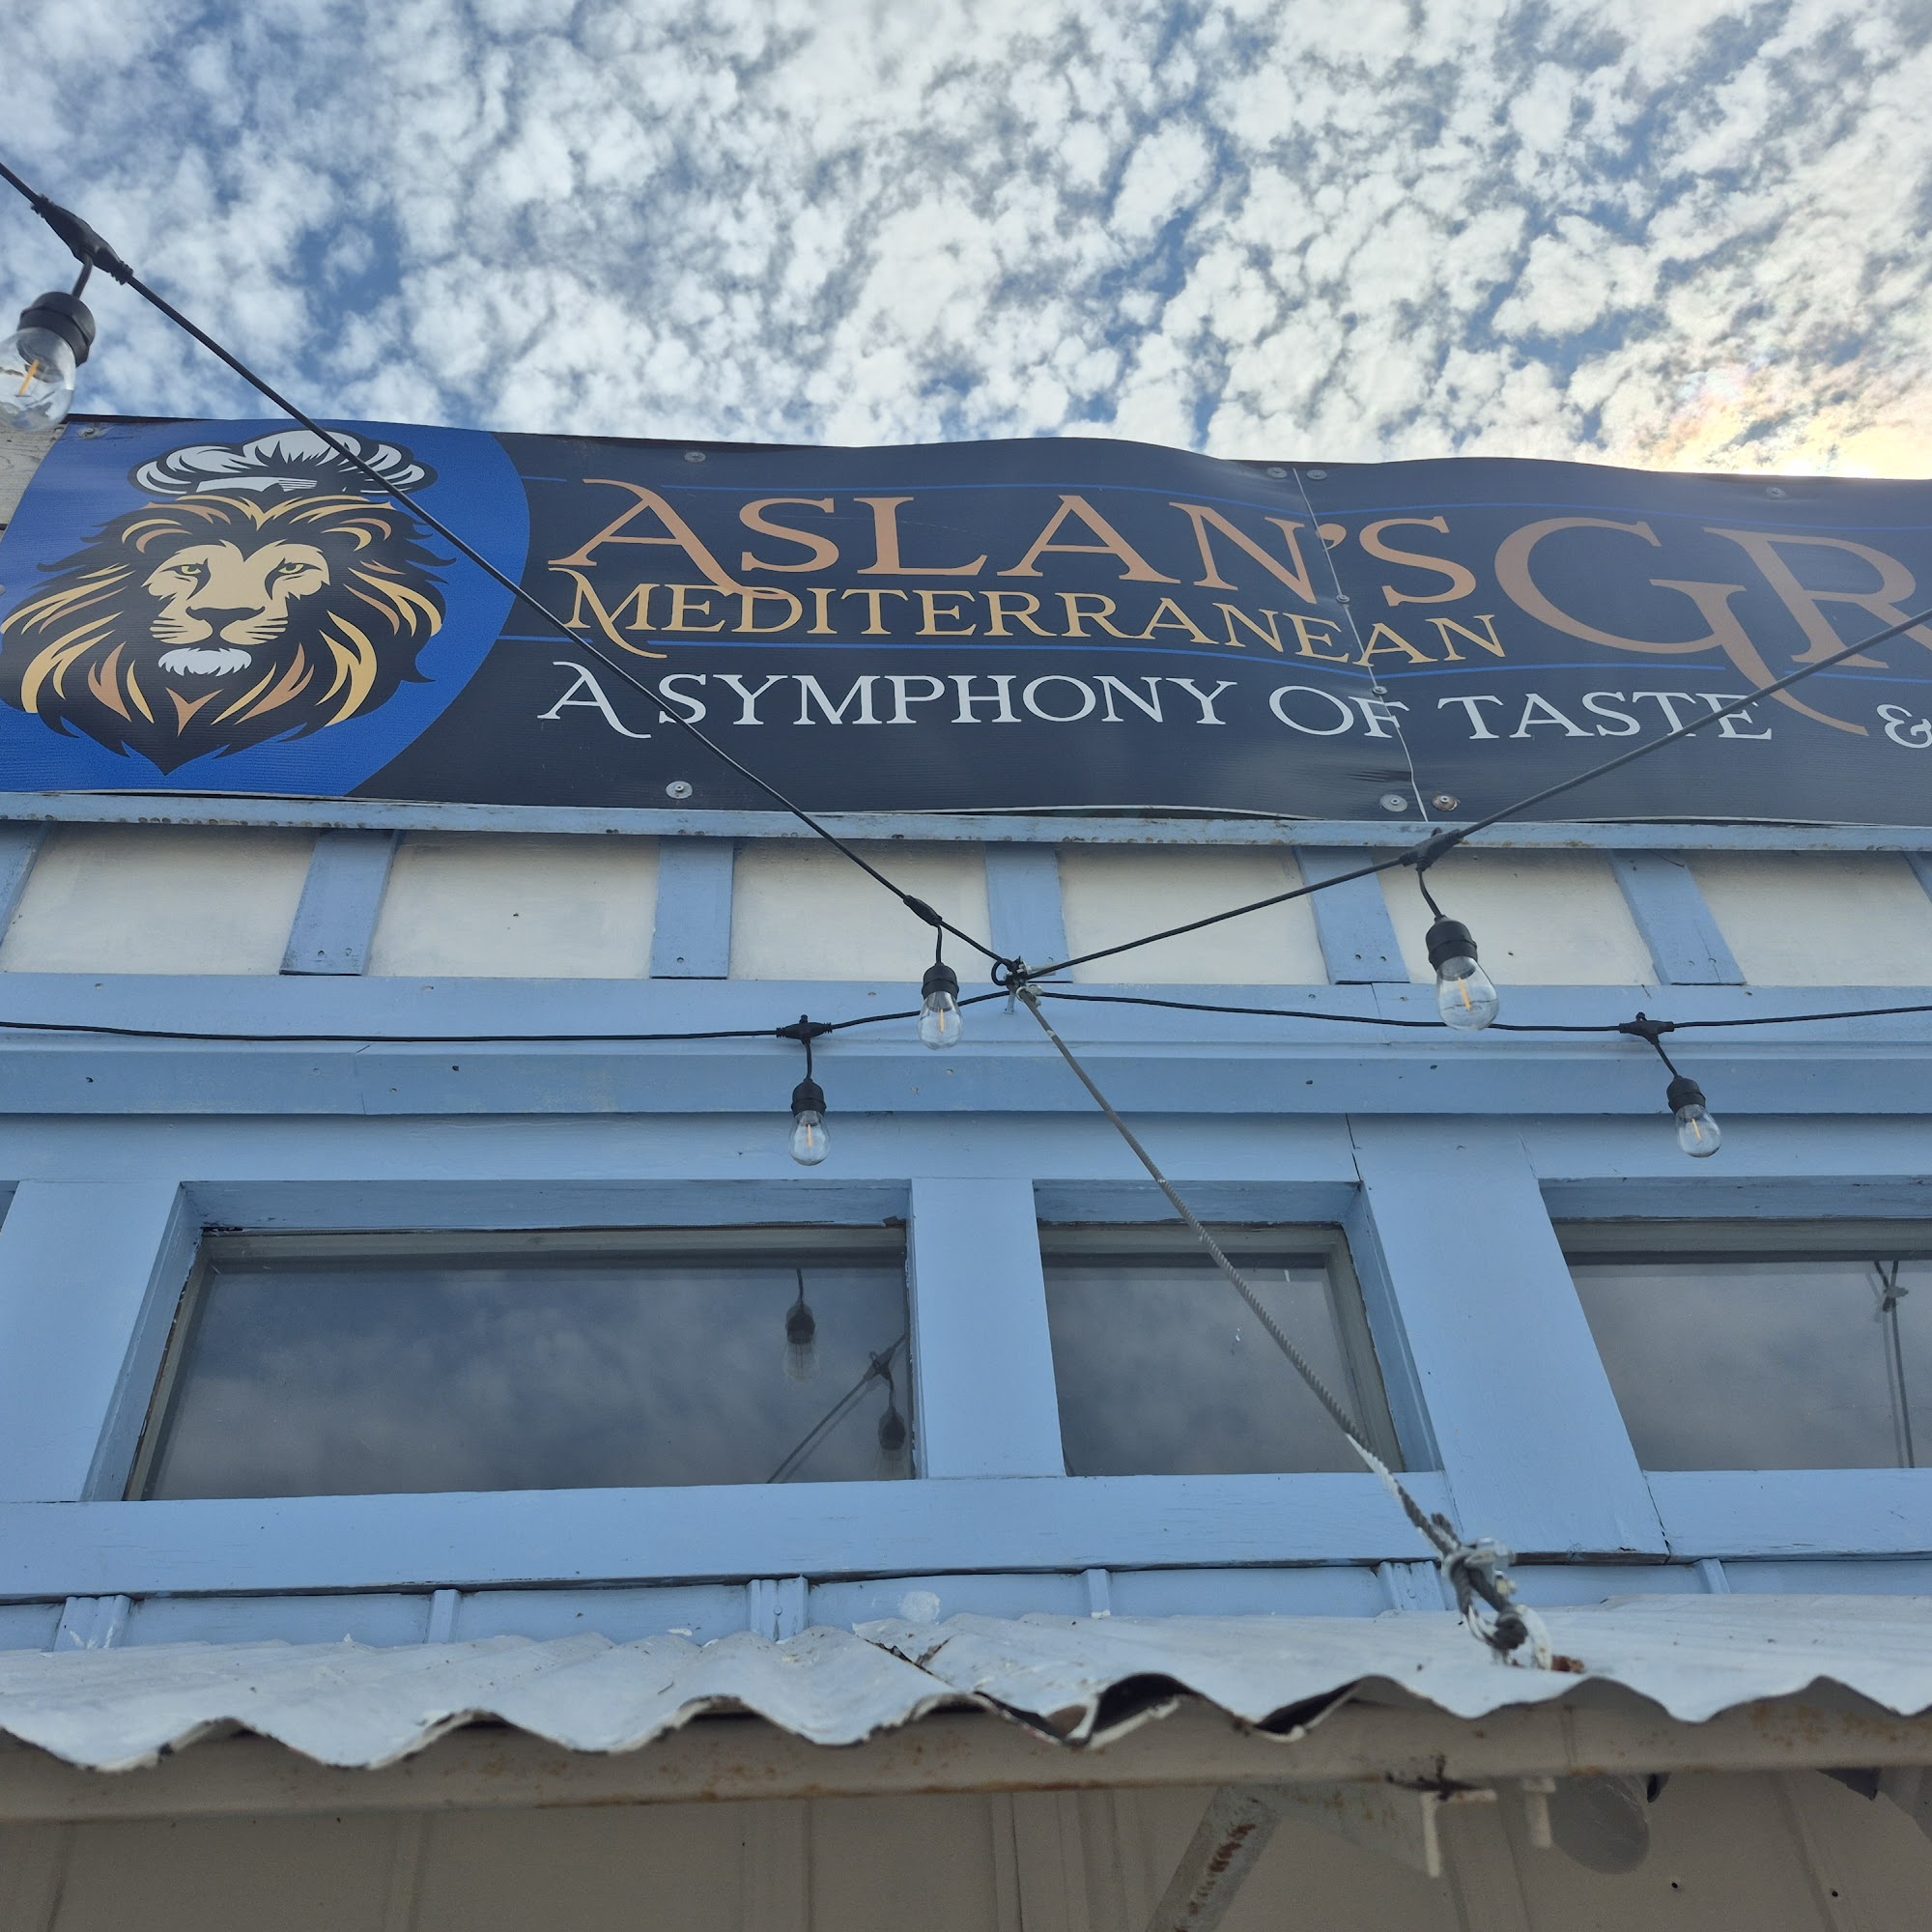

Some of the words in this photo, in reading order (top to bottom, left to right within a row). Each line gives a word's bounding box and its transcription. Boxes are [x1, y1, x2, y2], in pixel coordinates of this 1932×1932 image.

[548, 478, 1477, 607] ASLAN'S
[548, 567, 1507, 667] MEDITERRANEAN
[537, 662, 651, 739] A
[658, 673, 1237, 725] SYMPHONY
[1268, 685, 1410, 739] OF
[1437, 693, 1772, 740] TASTE
